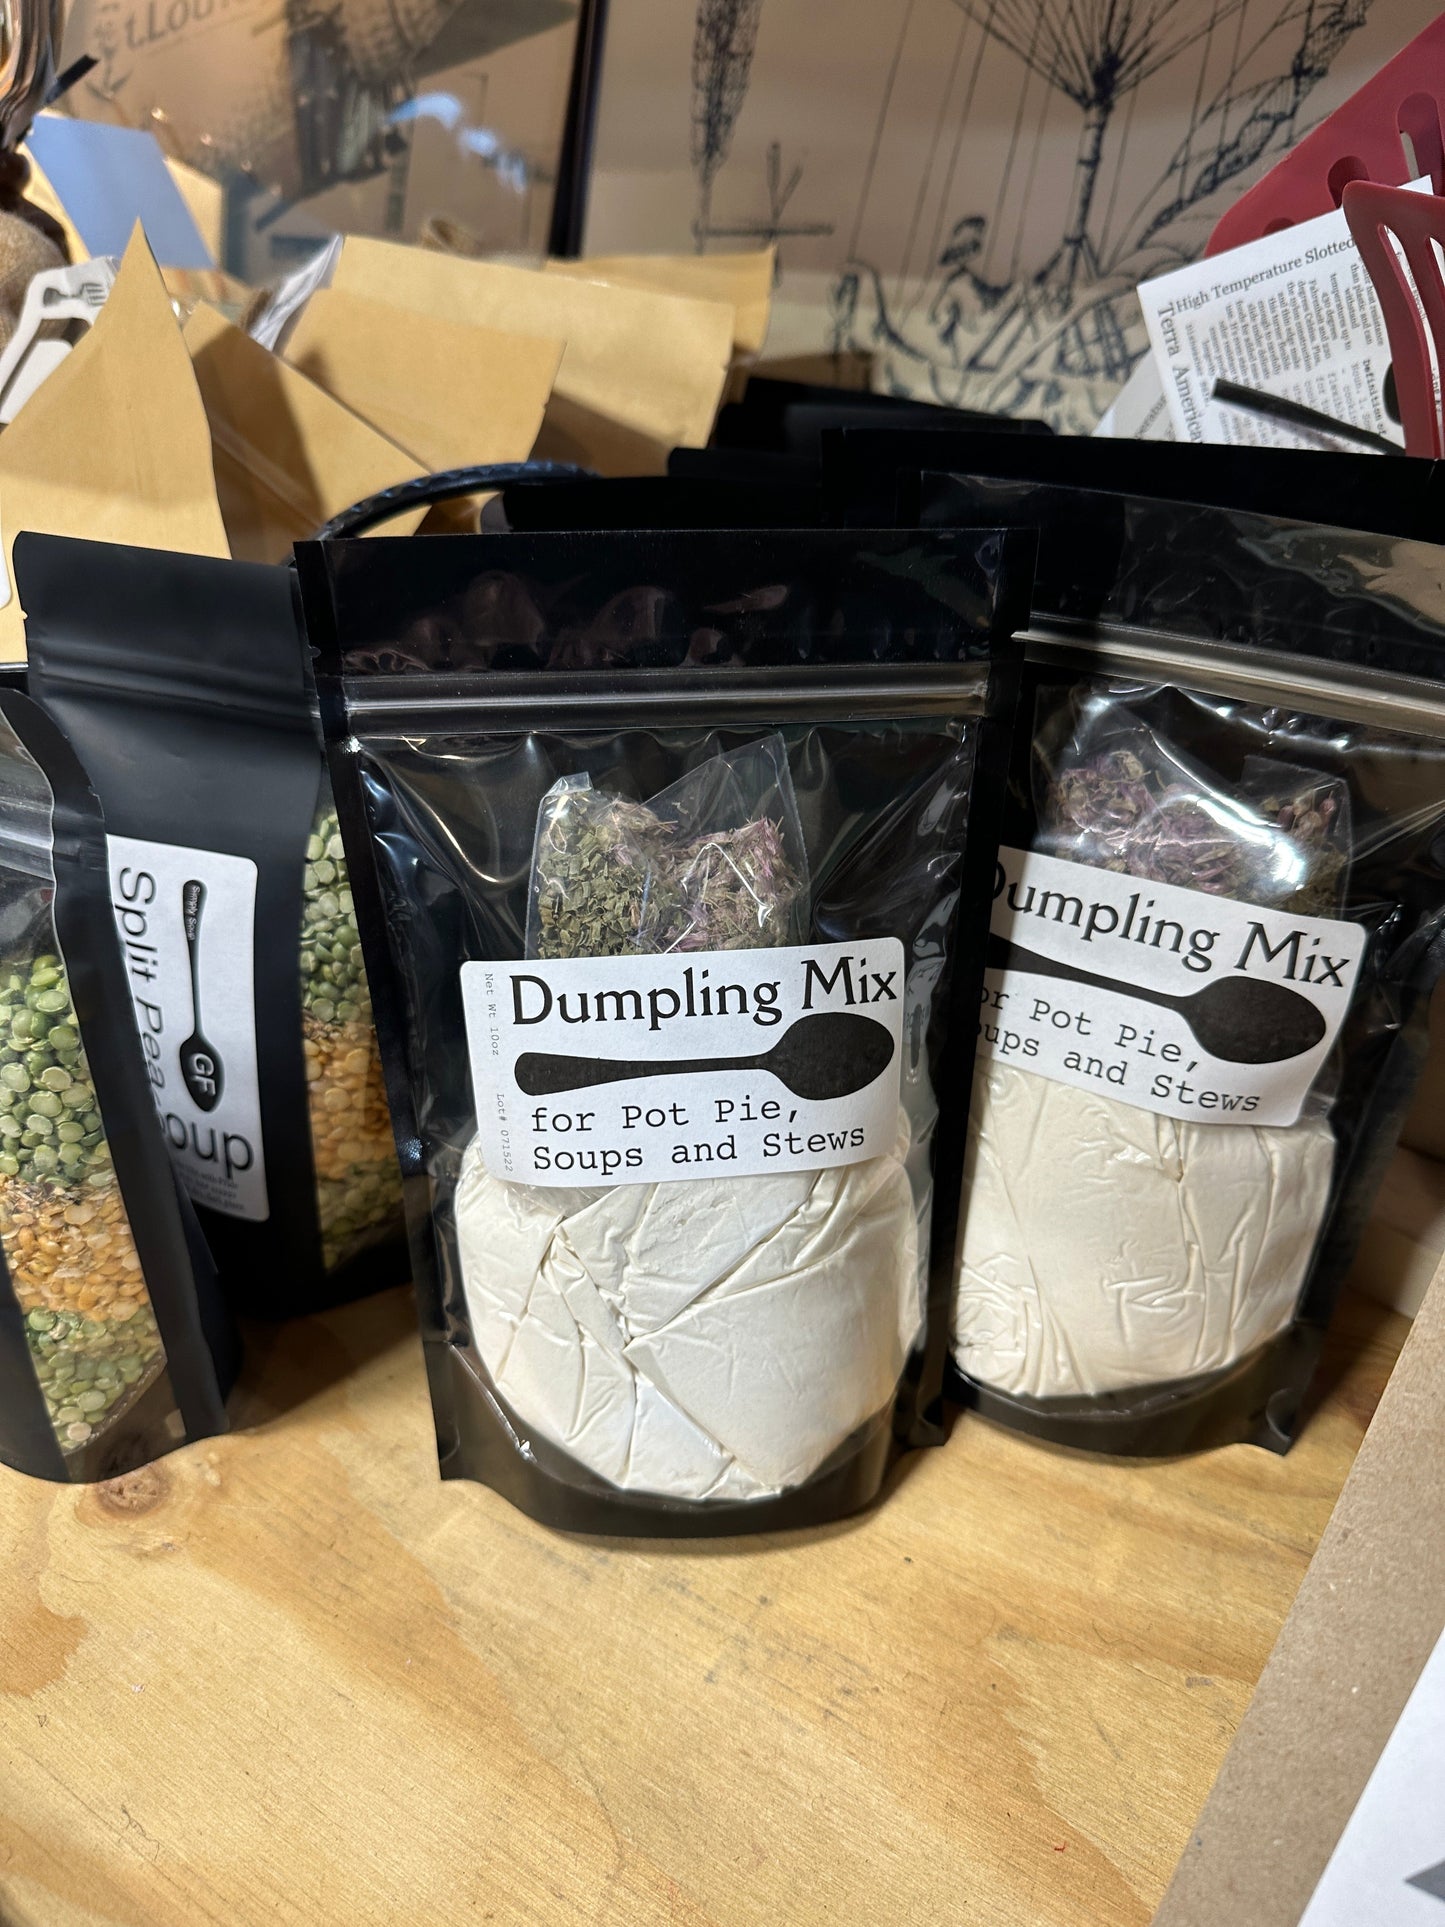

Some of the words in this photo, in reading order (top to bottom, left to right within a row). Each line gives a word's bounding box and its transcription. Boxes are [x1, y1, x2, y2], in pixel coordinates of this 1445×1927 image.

[1176, 290, 1210, 313] High
[1212, 257, 1303, 300] Temperature
[1351, 264, 1360, 283] than
[1298, 281, 1310, 312] degrees
[1310, 280, 1323, 325] Fahrenheit
[1319, 325, 1328, 342] and
[1330, 273, 1345, 328] temperatures
[1341, 330, 1348, 341] up
[1345, 342, 1352, 350] to
[1346, 288, 1358, 329] withstand
[1354, 285, 1365, 310] plastic
[1158, 302, 1180, 357] Terra
[1326, 309, 1338, 341] degrees
[1361, 313, 1370, 329] and
[1364, 330, 1372, 344] can
[1371, 305, 1383, 346] resistance
[1296, 321, 1311, 372] construction
[1363, 359, 1382, 421] Definition
[1234, 921, 1351, 988] Mix
[484, 973, 495, 996] Net
[509, 967, 783, 1031] Dumpling
[800, 956, 898, 1010] Mix
[114, 866, 158, 983] Split
[160, 1112, 254, 1179] oup
[487, 1003, 497, 1020] Wt
[490, 1027, 500, 1056] 10oz
[1029, 999, 1093, 1037] Pot
[1115, 1023, 1200, 1072] Pie,
[191, 1052, 217, 1097] GF
[1064, 1050, 1128, 1086] and
[1151, 1074, 1260, 1112] Stews
[496, 1093, 507, 1122] Lot#
[532, 1107, 595, 1133] for
[622, 1102, 690, 1130] Pot
[714, 1095, 799, 1125] Pie,
[500, 1130, 513, 1172] 071522
[533, 1144, 644, 1176] Soups
[671, 1135, 738, 1164] and
[763, 1127, 865, 1157] Stews
